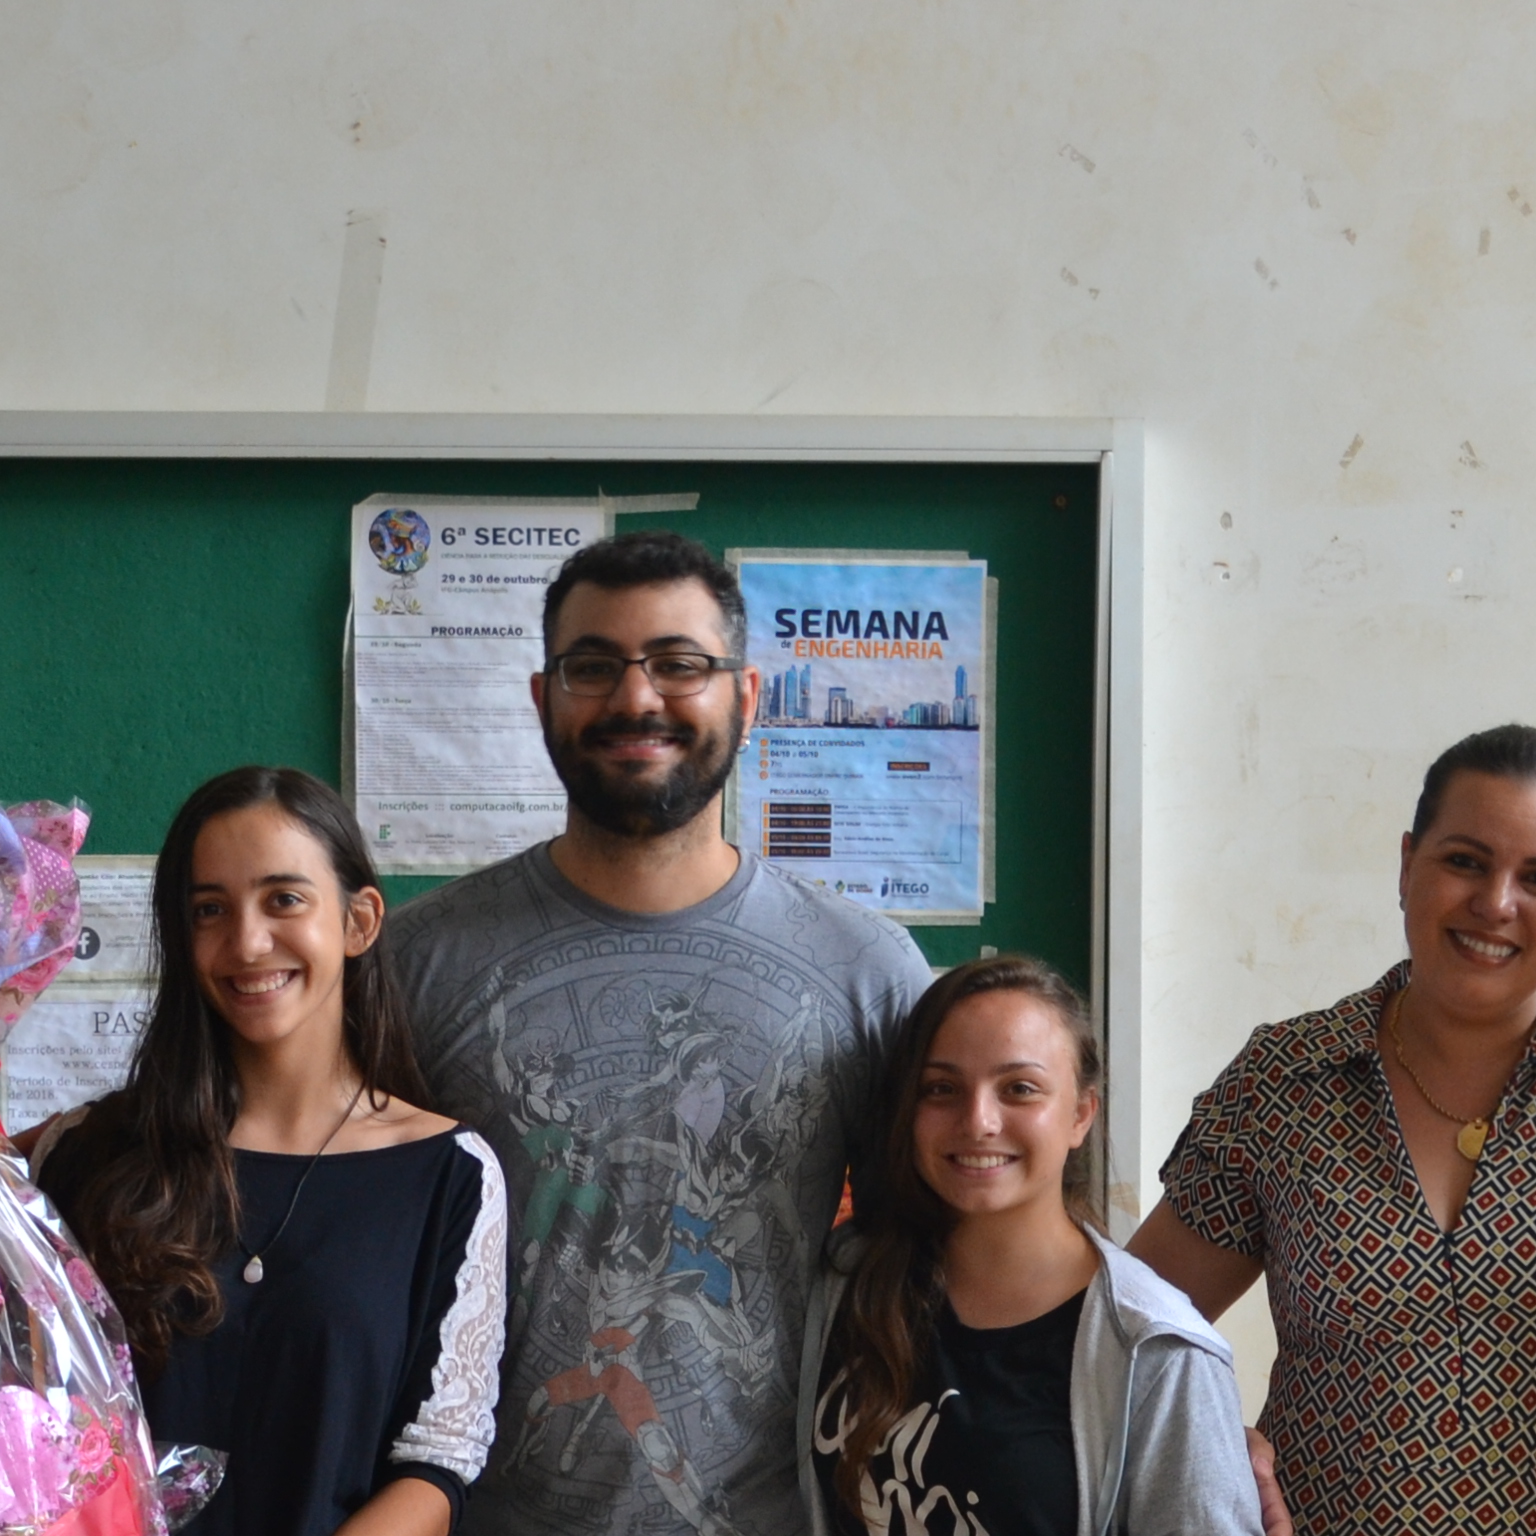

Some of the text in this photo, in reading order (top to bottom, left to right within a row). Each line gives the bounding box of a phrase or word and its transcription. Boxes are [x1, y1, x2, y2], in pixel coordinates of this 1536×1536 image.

[474, 526, 582, 547] SECITEC
[441, 573, 548, 585] 29 e 30 de outubro
[774, 607, 950, 641] SEMANA
[431, 625, 524, 638] PROGRAMAÇÃO
[780, 638, 944, 660] de ENGENHARIA
[770, 739, 806, 748] PRESENÇA
[769, 787, 830, 798] PROGRAMAÇÃO
[378, 801, 429, 813] Inscrições
[891, 882, 930, 894] ITEGO
[7, 1045, 65, 1057] Inscrições
[69, 1045, 93, 1057] pelo
[57, 1076, 71, 1087] de
[8, 1089, 58, 1101] de 2018.
[8, 1107, 38, 1119] Taxa
